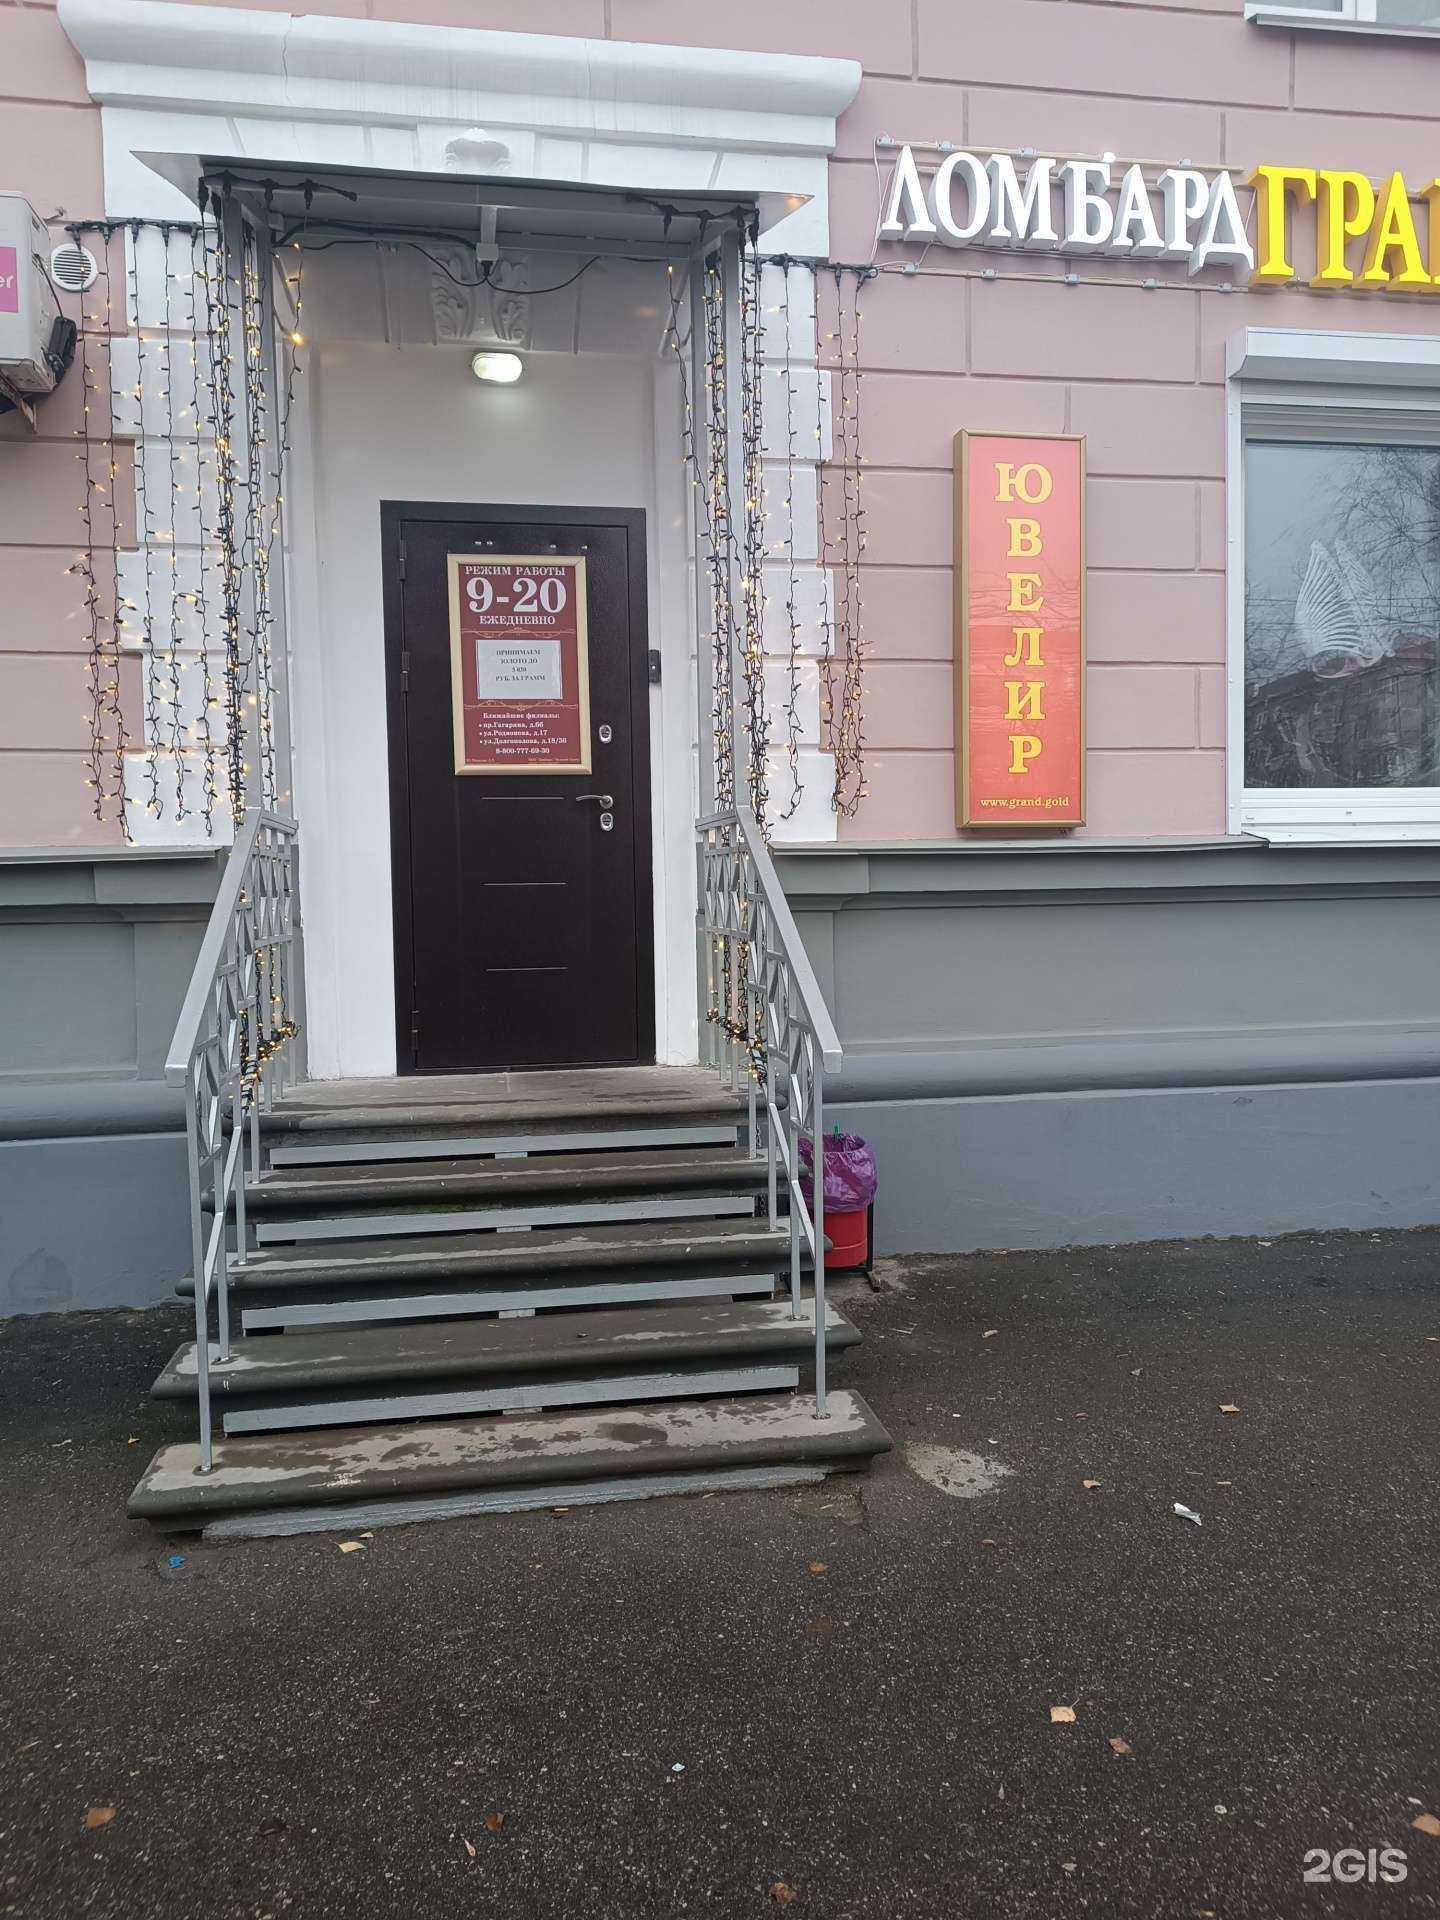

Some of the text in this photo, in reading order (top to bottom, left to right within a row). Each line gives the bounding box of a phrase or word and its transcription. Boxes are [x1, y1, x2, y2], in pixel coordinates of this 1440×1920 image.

[880, 145, 1440, 288] ЛОМБАРД ГРА
[465, 566, 566, 576] РЕЖИМ РАБОТЫ
[466, 577, 567, 613] 9-20
[479, 615, 556, 626] ЕЖЕДНЕВНО
[993, 461, 1054, 775] ЮВЕЛИР
[526, 712, 560, 720] филиалы:
[980, 797, 1069, 809] www.grand.gold
